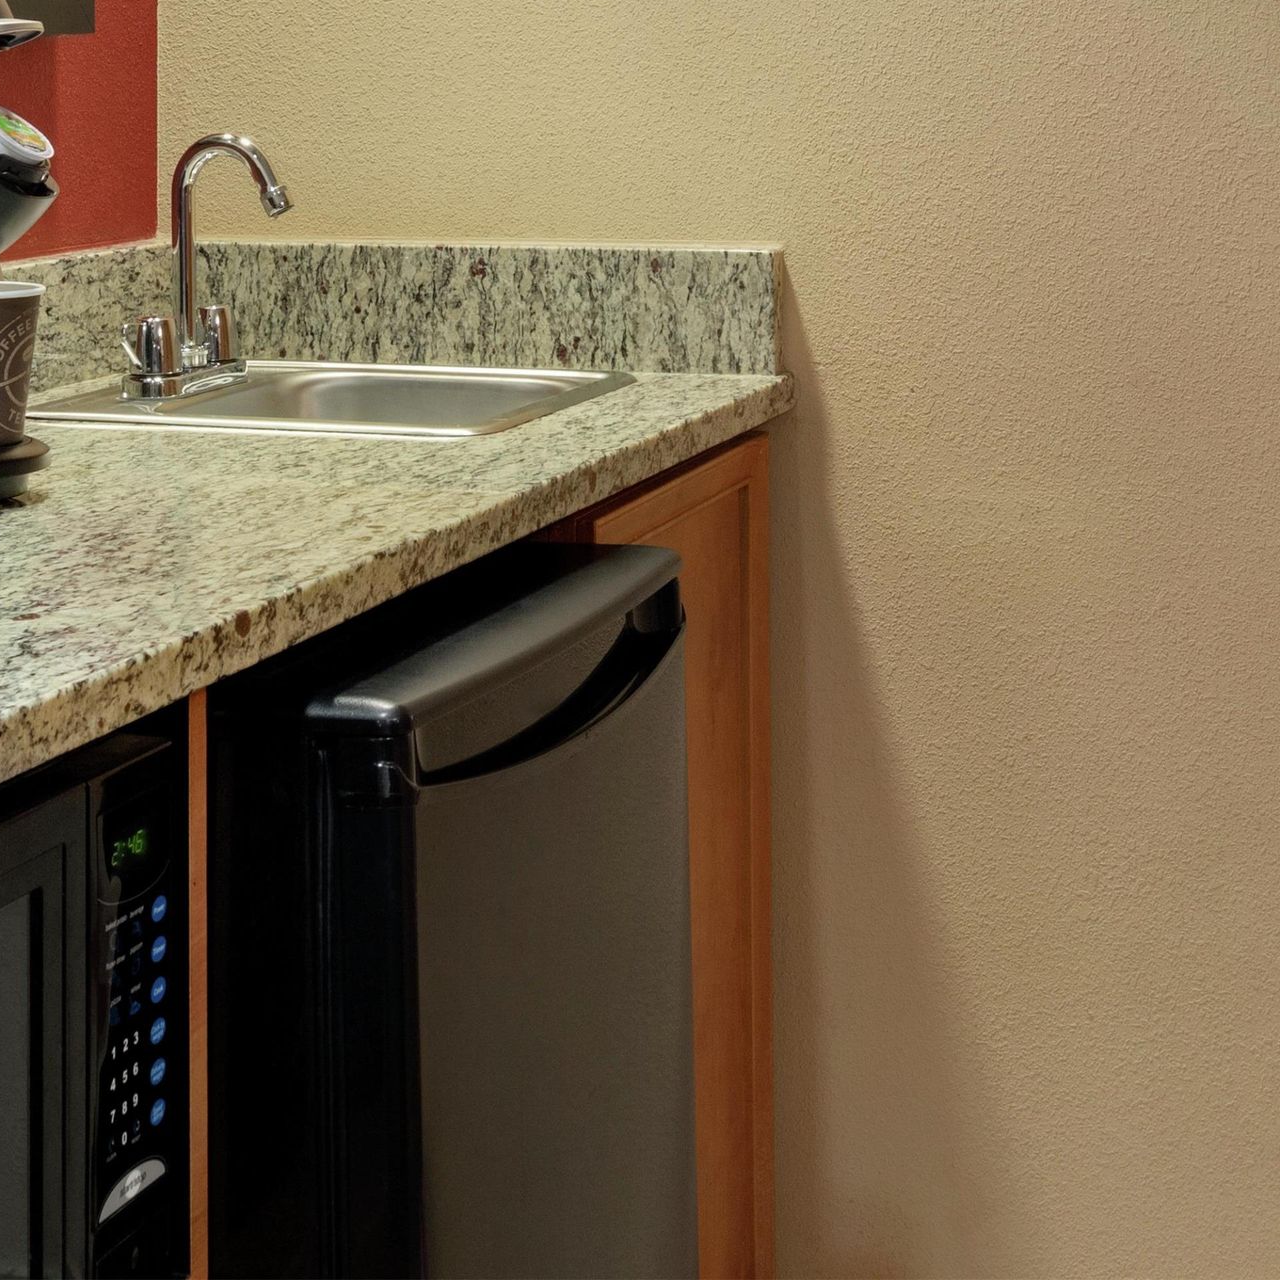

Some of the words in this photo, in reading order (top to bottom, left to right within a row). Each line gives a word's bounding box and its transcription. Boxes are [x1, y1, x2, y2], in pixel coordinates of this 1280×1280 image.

[111, 1047, 116, 1060] 1
[123, 1038, 129, 1052] 2
[133, 1031, 139, 1045] 3
[110, 1078, 116, 1091] 4
[122, 1069, 128, 1083] 5
[133, 1062, 139, 1076] 6
[110, 1109, 116, 1124] 7
[122, 1101, 128, 1115] 8
[132, 1093, 138, 1107] 9
[121, 1131, 128, 1146] 0
